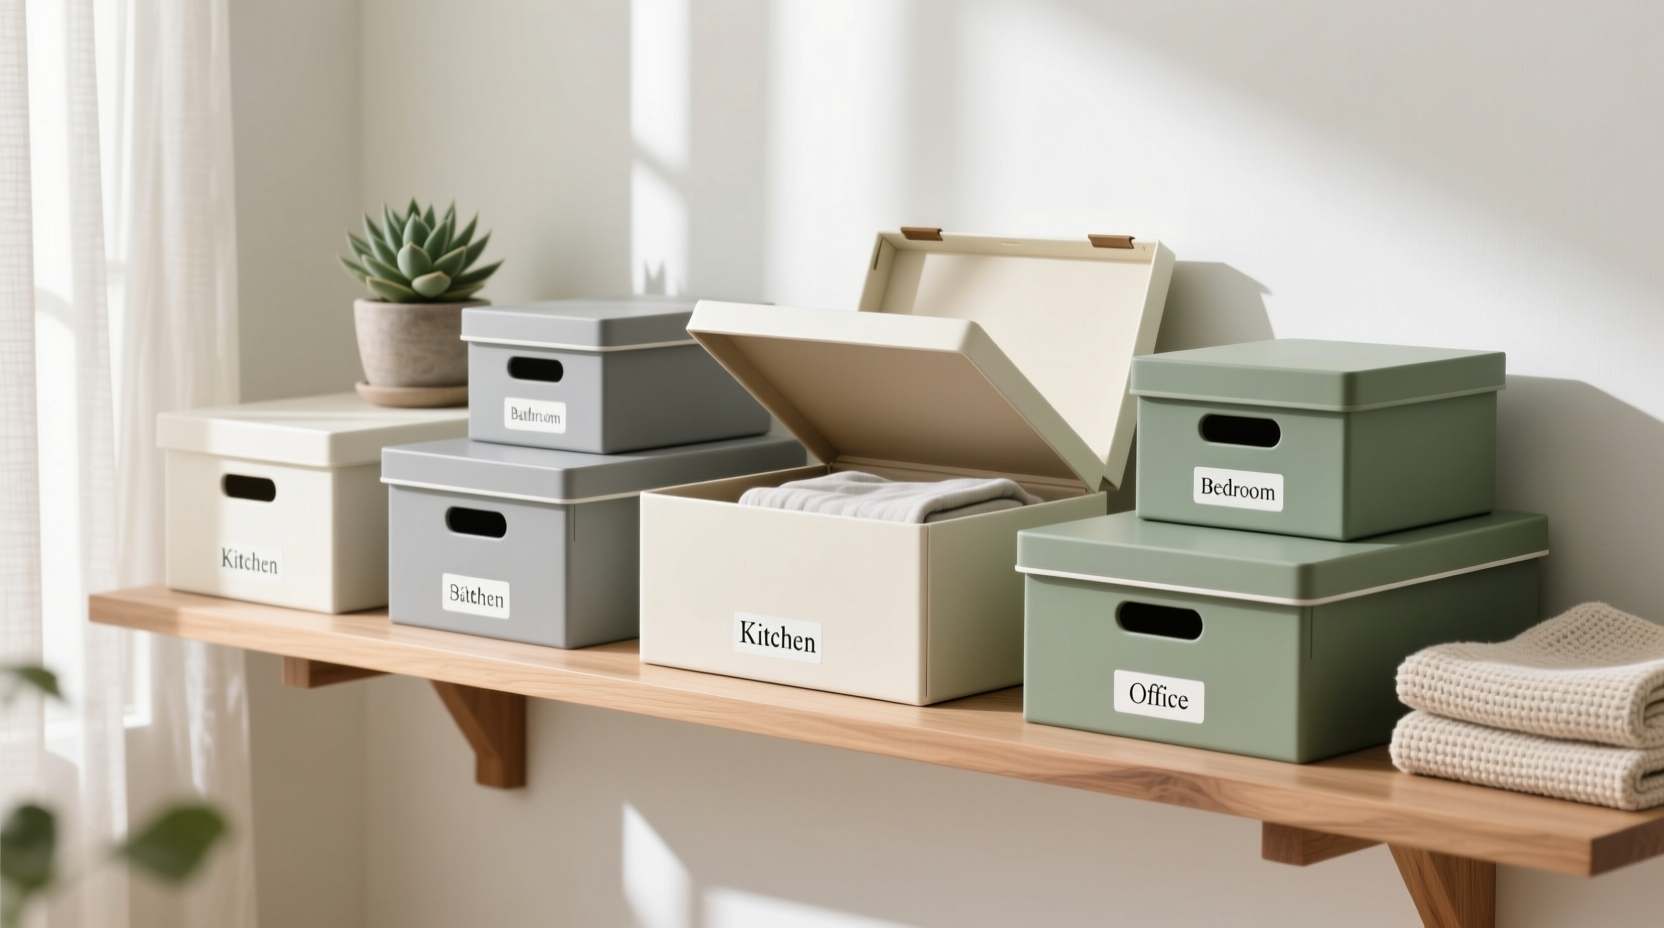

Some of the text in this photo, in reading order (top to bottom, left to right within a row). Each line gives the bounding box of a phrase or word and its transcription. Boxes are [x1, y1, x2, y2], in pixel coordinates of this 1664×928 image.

[1201, 477, 1275, 501] Bedroom
[222, 547, 278, 575] Kitchen
[738, 620, 816, 653] Kitchen
[1129, 682, 1189, 710] Office
